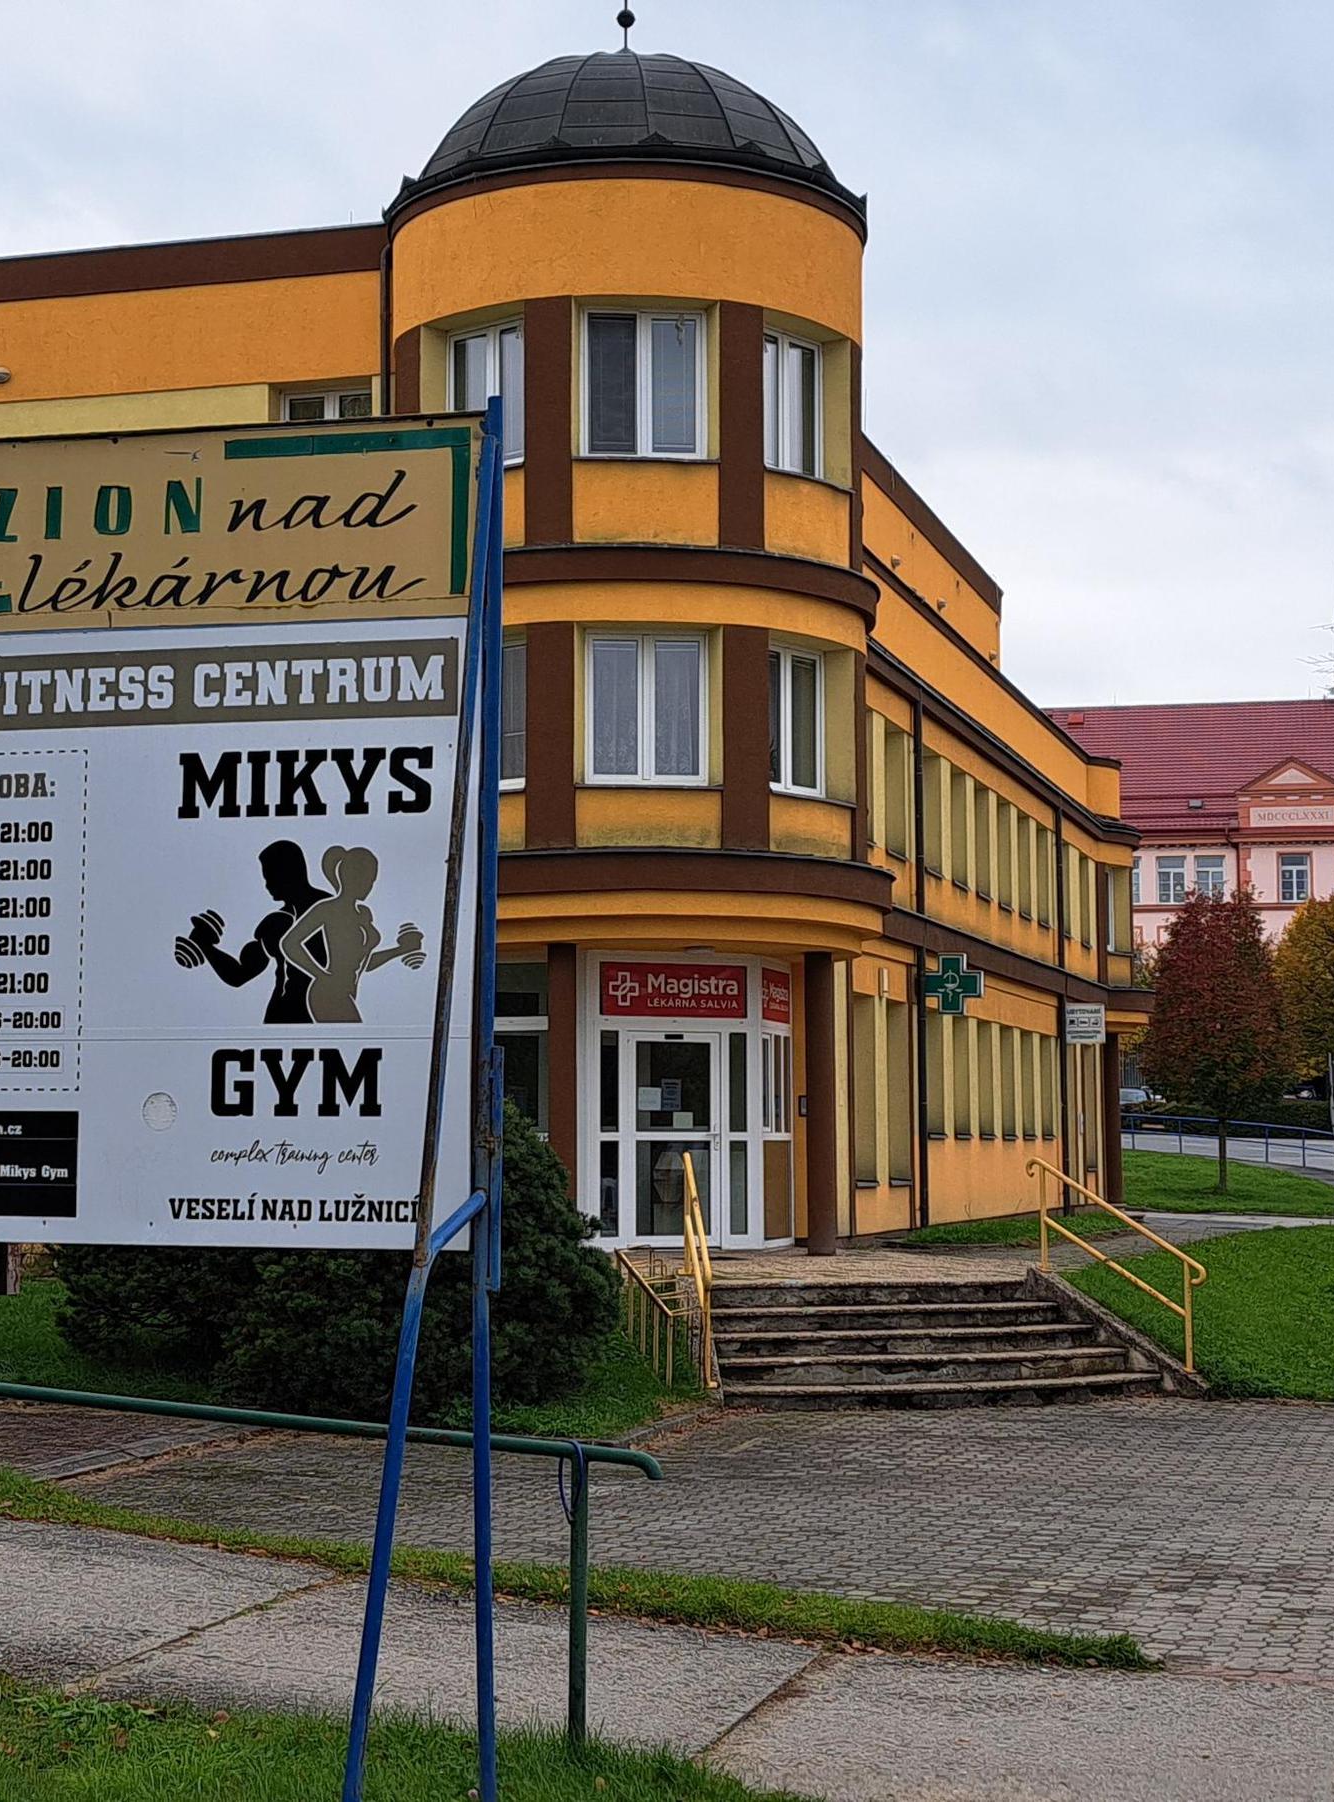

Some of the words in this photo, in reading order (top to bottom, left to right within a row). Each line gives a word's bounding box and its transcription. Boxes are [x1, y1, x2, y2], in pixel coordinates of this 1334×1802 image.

[227, 470, 417, 532] nad
[15, 552, 427, 613] lékárnou
[193, 654, 445, 708] CENTRUM
[178, 746, 433, 819] MIKYS
[0, 821, 53, 844] 21:00
[647, 973, 739, 998] Magistra
[647, 997, 697, 1008] LÉKÁRNA
[699, 998, 739, 1010] SALVIA
[211, 1048, 382, 1116] GYM
[0, 1163, 38, 1181] Mikys
[41, 1164, 69, 1181] Gym
[210, 1139, 275, 1167] complex
[274, 1140, 332, 1175] training
[337, 1140, 379, 1167] center
[168, 1192, 258, 1221] VESELÍ
[260, 1198, 313, 1222] NAD
[318, 1193, 420, 1223] LUŽNICÍ
